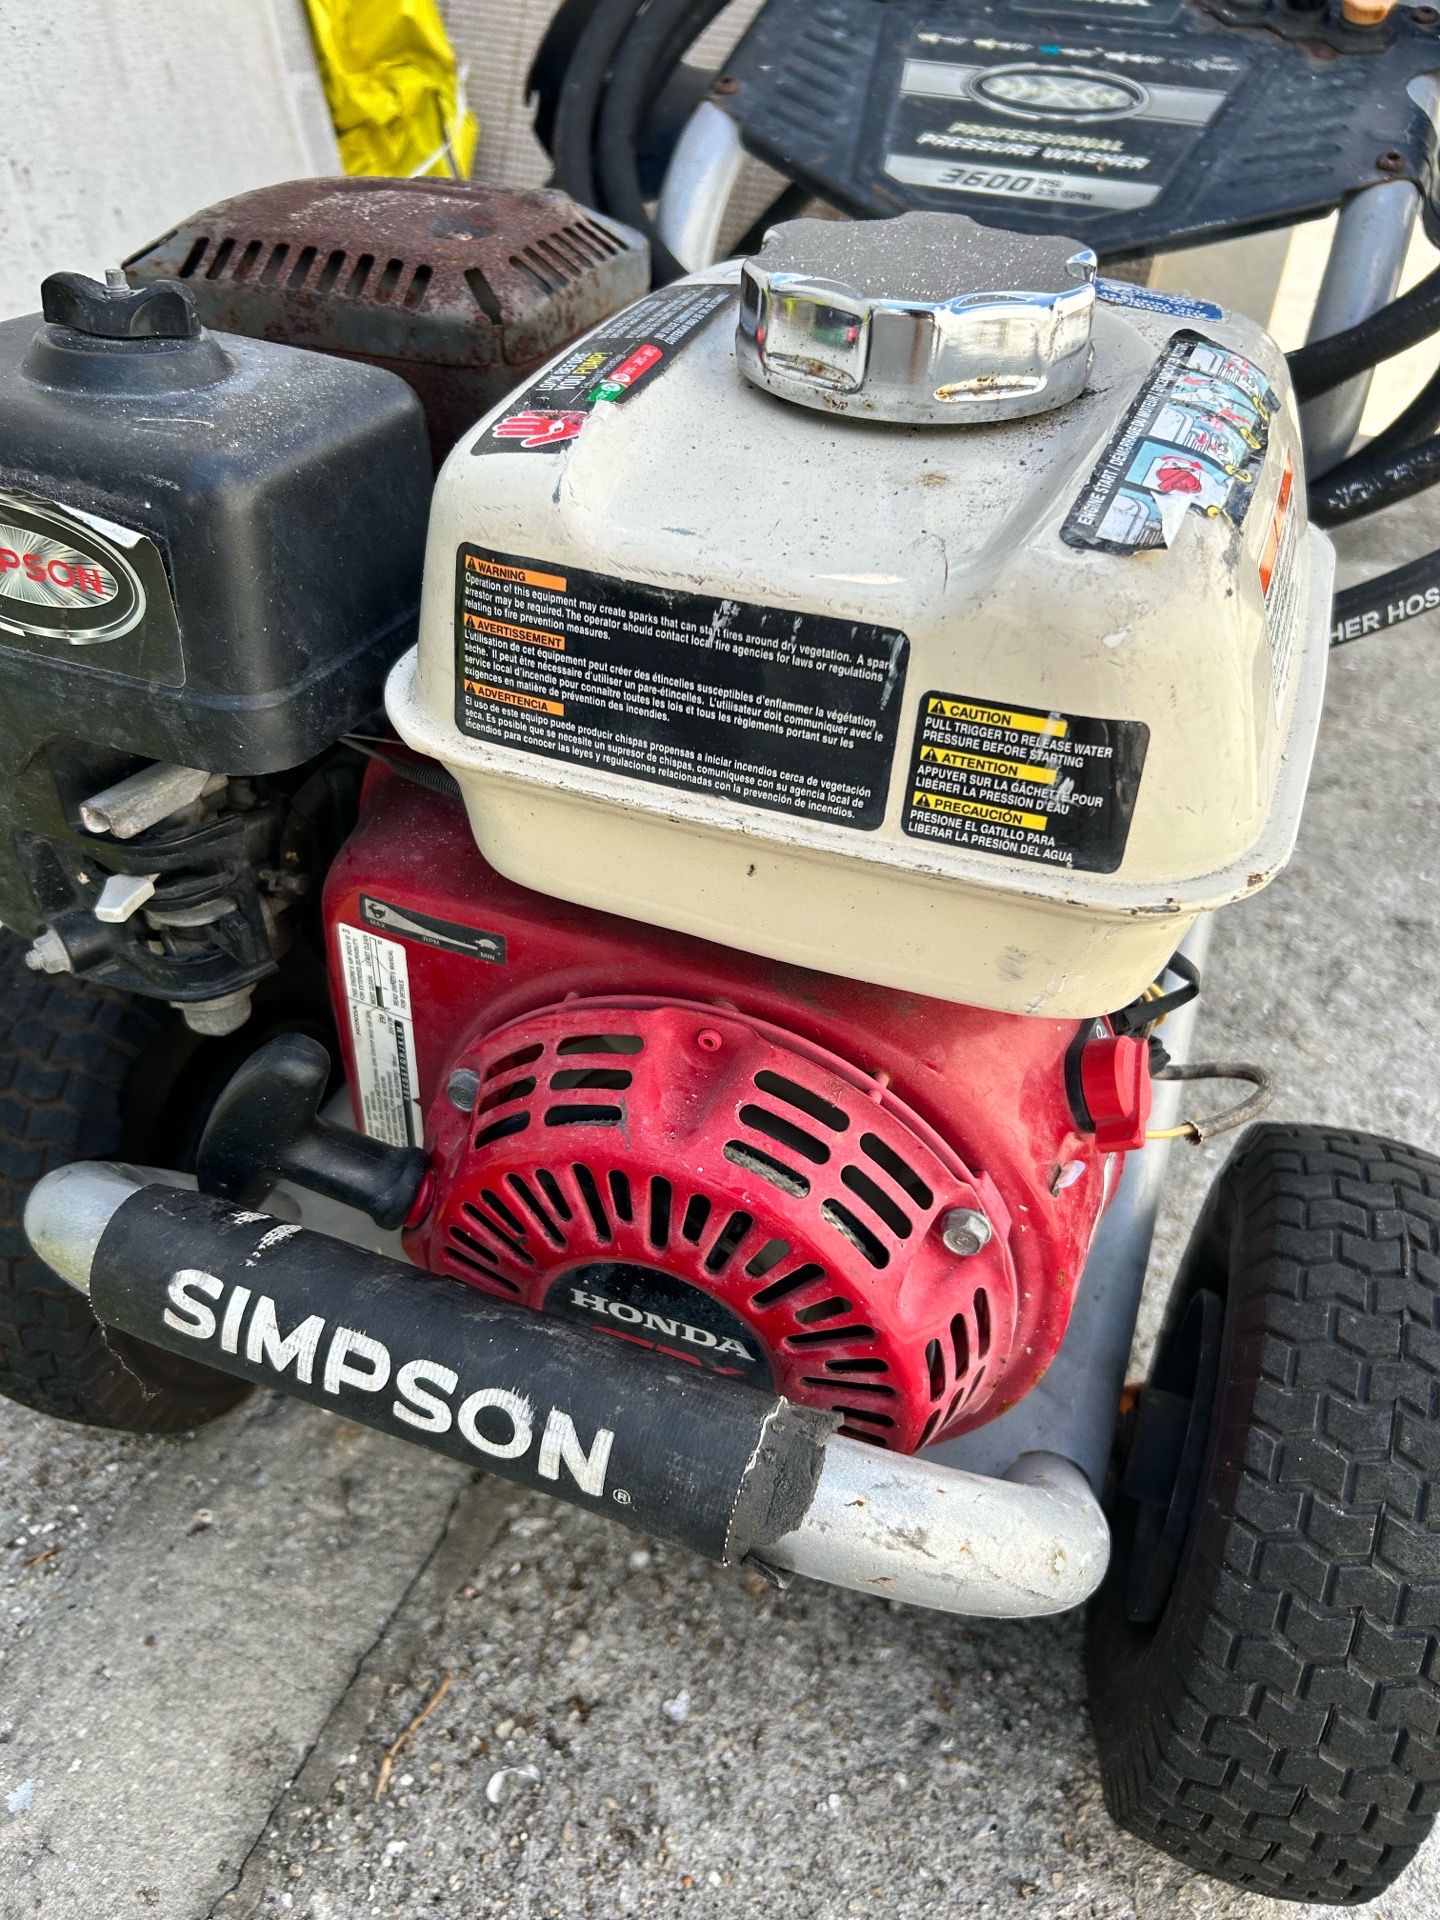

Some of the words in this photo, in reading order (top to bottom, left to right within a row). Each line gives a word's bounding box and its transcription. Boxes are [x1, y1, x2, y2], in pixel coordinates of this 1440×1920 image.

[917, 132, 1042, 156] PRESSURE
[1042, 148, 1150, 170] WASHER
[948, 122, 1124, 151] PROFESSIONAL
[937, 168, 1034, 192] 3600
[535, 376, 564, 390] LOOK
[554, 376, 586, 390] YOU
[1078, 492, 1106, 525] ENGINE
[1096, 470, 1118, 494] START
[478, 562, 526, 581] WARNING
[465, 573, 501, 592] Operation
[503, 583, 512, 593] of
[514, 585, 530, 598] this
[531, 590, 577, 608] equipment
[579, 601, 597, 613] may
[599, 605, 626, 618] create
[629, 611, 658, 624] sparks
[660, 616, 678, 629] that
[680, 621, 697, 632] can
[699, 624, 721, 638] start
[723, 628, 743, 642] fires
[745, 635, 779, 649] around
[781, 640, 797, 654] dry
[799, 645, 852, 663] vegetation.
[856, 654, 864, 666] A
[465, 599, 492, 616] relating
[494, 606, 502, 617] to
[504, 607, 518, 620] fire
[520, 613, 564, 630] prevention
[566, 623, 610, 640] measures.
[465, 586, 493, 602] arrestor
[495, 595, 512, 608] may
[514, 597, 525, 609] be
[527, 602, 564, 618] required.
[565, 608, 581, 621] The
[583, 614, 621, 629] operator
[623, 621, 653, 636] should
[655, 629, 689, 644] contact
[691, 634, 714, 648] local
[714, 639, 730, 652] fire
[732, 645, 774, 661] agencies
[776, 652, 790, 664] for
[792, 655, 813, 669] laws
[816, 661, 827, 671] or
[828, 664, 883, 682] regulations
[478, 619, 562, 648] AVERTISSEMENT
[464, 629, 508, 650] L'utilisation
[509, 642, 520, 653] de
[522, 646, 535, 656] cet
[537, 647, 586, 668] équipement
[588, 661, 608, 672] peut
[609, 665, 632, 677] créer
[634, 669, 650, 681] des
[652, 672, 695, 691] étincelles
[697, 683, 754, 703] susceptibles
[756, 695, 814, 715] d'enflammer
[815, 706, 824, 717] la
[826, 710, 876, 731] végétation
[464, 643, 488, 656] sèche.
[492, 649, 497, 659] Il
[499, 652, 517, 664] peut
[519, 655, 535, 668] être
[537, 660, 582, 679] nécessaire
[584, 670, 623, 687] d'utiliser
[624, 680, 636, 690] un
[638, 683, 704, 705] pare-étincelles.
[709, 697, 762, 717] L'utilisateur
[763, 709, 782, 721] doit
[783, 714, 848, 735] communiquer
[849, 728, 873, 740] avec
[874, 731, 884, 742] le
[478, 687, 548, 711] ADVERTENCIA
[464, 654, 491, 669] service
[493, 661, 512, 674] local
[514, 666, 557, 685] d'incendie
[559, 678, 579, 689] pour
[581, 683, 621, 699] connaître
[623, 691, 650, 705] toutes
[652, 696, 665, 709] les
[667, 700, 683, 713] lois
[685, 705, 694, 715] et
[696, 707, 716, 720] tous
[718, 711, 731, 723] les
[734, 715, 784, 734] règlements
[786, 727, 820, 742] portant
[822, 735, 838, 745] sur
[840, 737, 854, 749] les
[950, 705, 1011, 726] CAUTION
[465, 695, 472, 706] El
[474, 700, 488, 711] uso
[489, 703, 500, 713] de
[501, 707, 519, 718] este
[520, 712, 549, 725] equipo
[550, 719, 576, 732] puede
[578, 726, 613, 740] producir
[615, 733, 648, 749] chispas
[649, 742, 695, 759] propensas
[697, 753, 702, 761] a
[704, 753, 732, 767] iniciar
[734, 759, 777, 778] incendios
[779, 771, 804, 784] cerca
[806, 776, 818, 787] de
[821, 780, 871, 798] vegetación
[923, 729, 981, 750] PRESSURE
[982, 740, 1027, 758] BEFORE
[1028, 748, 1084, 768] STARTING
[925, 716, 952, 731] PULL
[954, 722, 1002, 740] TRIGGER
[1004, 731, 1019, 743] TO
[1020, 734, 1072, 753] RELEASE
[1074, 743, 1113, 758] WATER
[942, 753, 1018, 776] ATTENTION
[915, 776, 961, 794] LIBÉRER
[962, 786, 976, 798] LA
[979, 789, 1034, 809] PRESSION
[1035, 798, 1071, 815] D'EAU
[917, 764, 967, 783] APPUYER
[969, 774, 992, 788] SUR
[993, 779, 1008, 791] LA
[1070, 793, 1104, 808] POUR
[910, 809, 963, 829] PRESIONE
[964, 820, 978, 832] EL
[980, 824, 1025, 841] GATILLO
[1026, 832, 1055, 847] PARA
[934, 799, 1023, 825] PRECAUCIÓN
[908, 821, 953, 839] LIBERAR
[955, 831, 968, 843] LA
[970, 834, 1018, 852] PRESIÓN
[1019, 844, 1041, 857] DEL
[1042, 849, 1073, 865] AGUA
[370, 919, 386, 929] MAX
[423, 936, 440, 946] RPM
[480, 952, 495, 960] MIN
[571, 1288, 757, 1362] HONDA
[164, 1269, 614, 1498] SIMPSON
